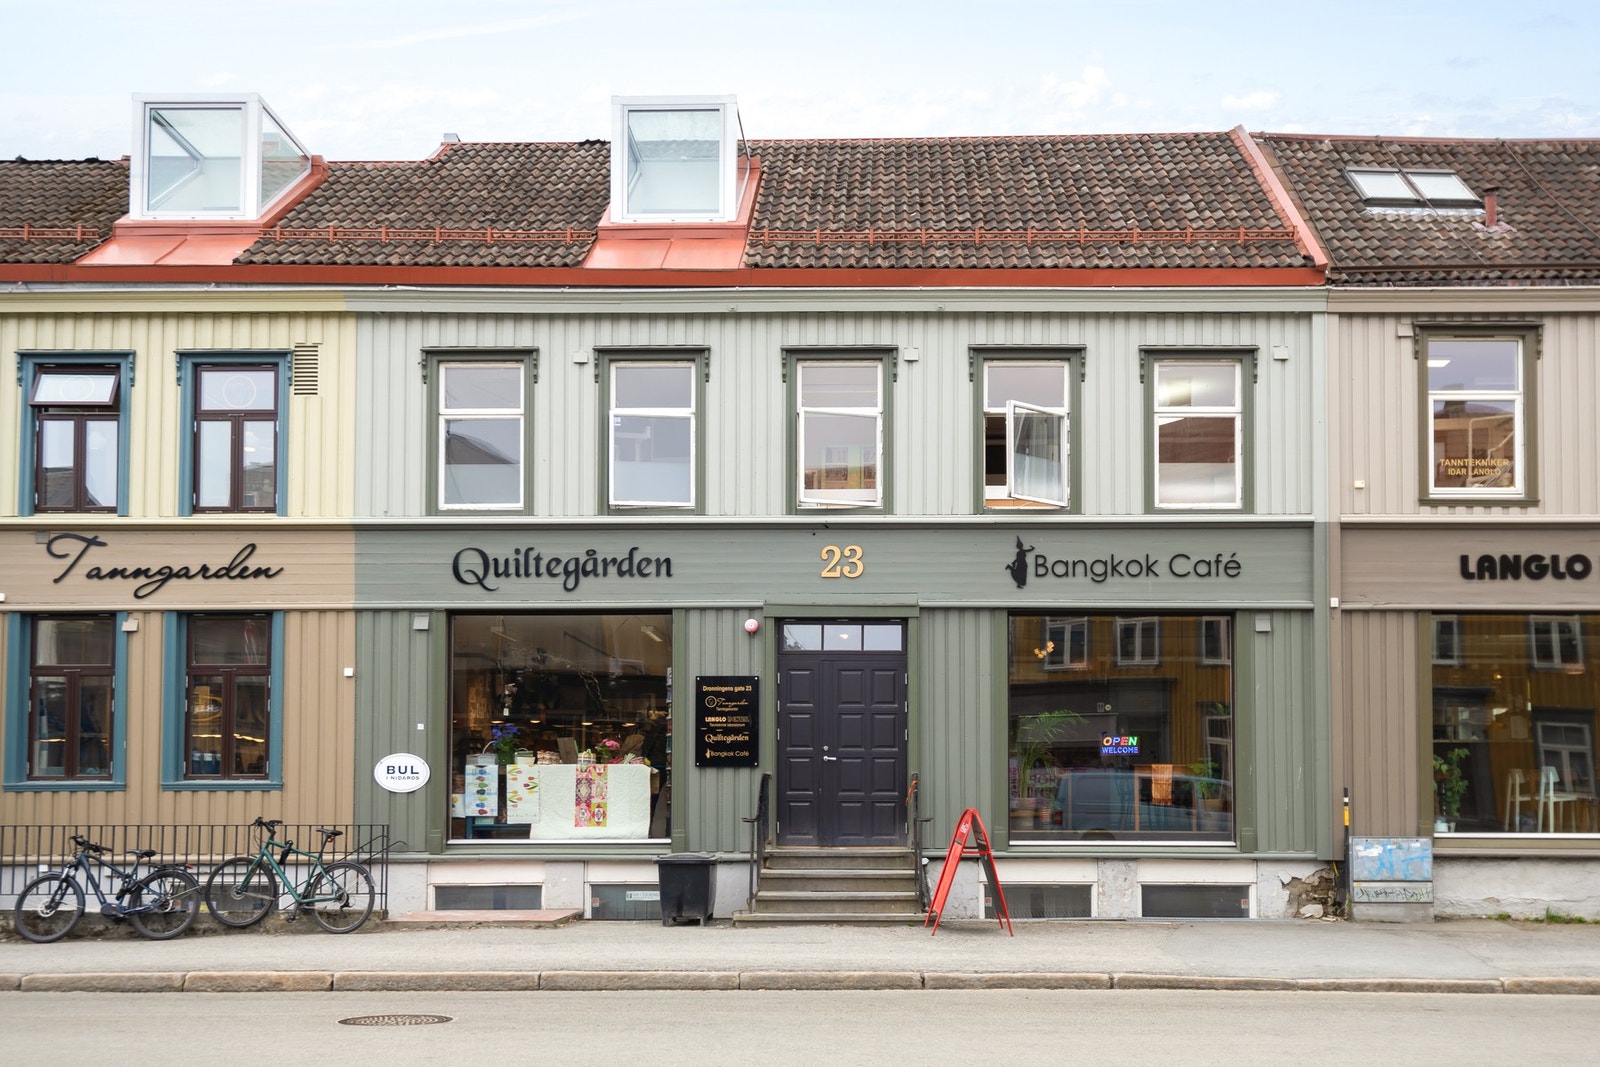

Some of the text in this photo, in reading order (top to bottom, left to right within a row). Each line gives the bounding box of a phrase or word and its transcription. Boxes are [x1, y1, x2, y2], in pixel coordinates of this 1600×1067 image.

[1440, 459, 1510, 467] TANNTEKNIKER
[1448, 468, 1502, 476] IDAR LANGLO
[46, 533, 284, 599] Tanngarden
[821, 545, 864, 578] 23
[452, 547, 673, 592] Quiltegården
[1034, 553, 1242, 583] Bangkok Café
[1460, 554, 1592, 580] LANGLO
[705, 733, 749, 743] Quiltegården
[1103, 736, 1138, 746] OPEN
[1101, 746, 1139, 754] WELCOME
[386, 765, 420, 774] BUL
